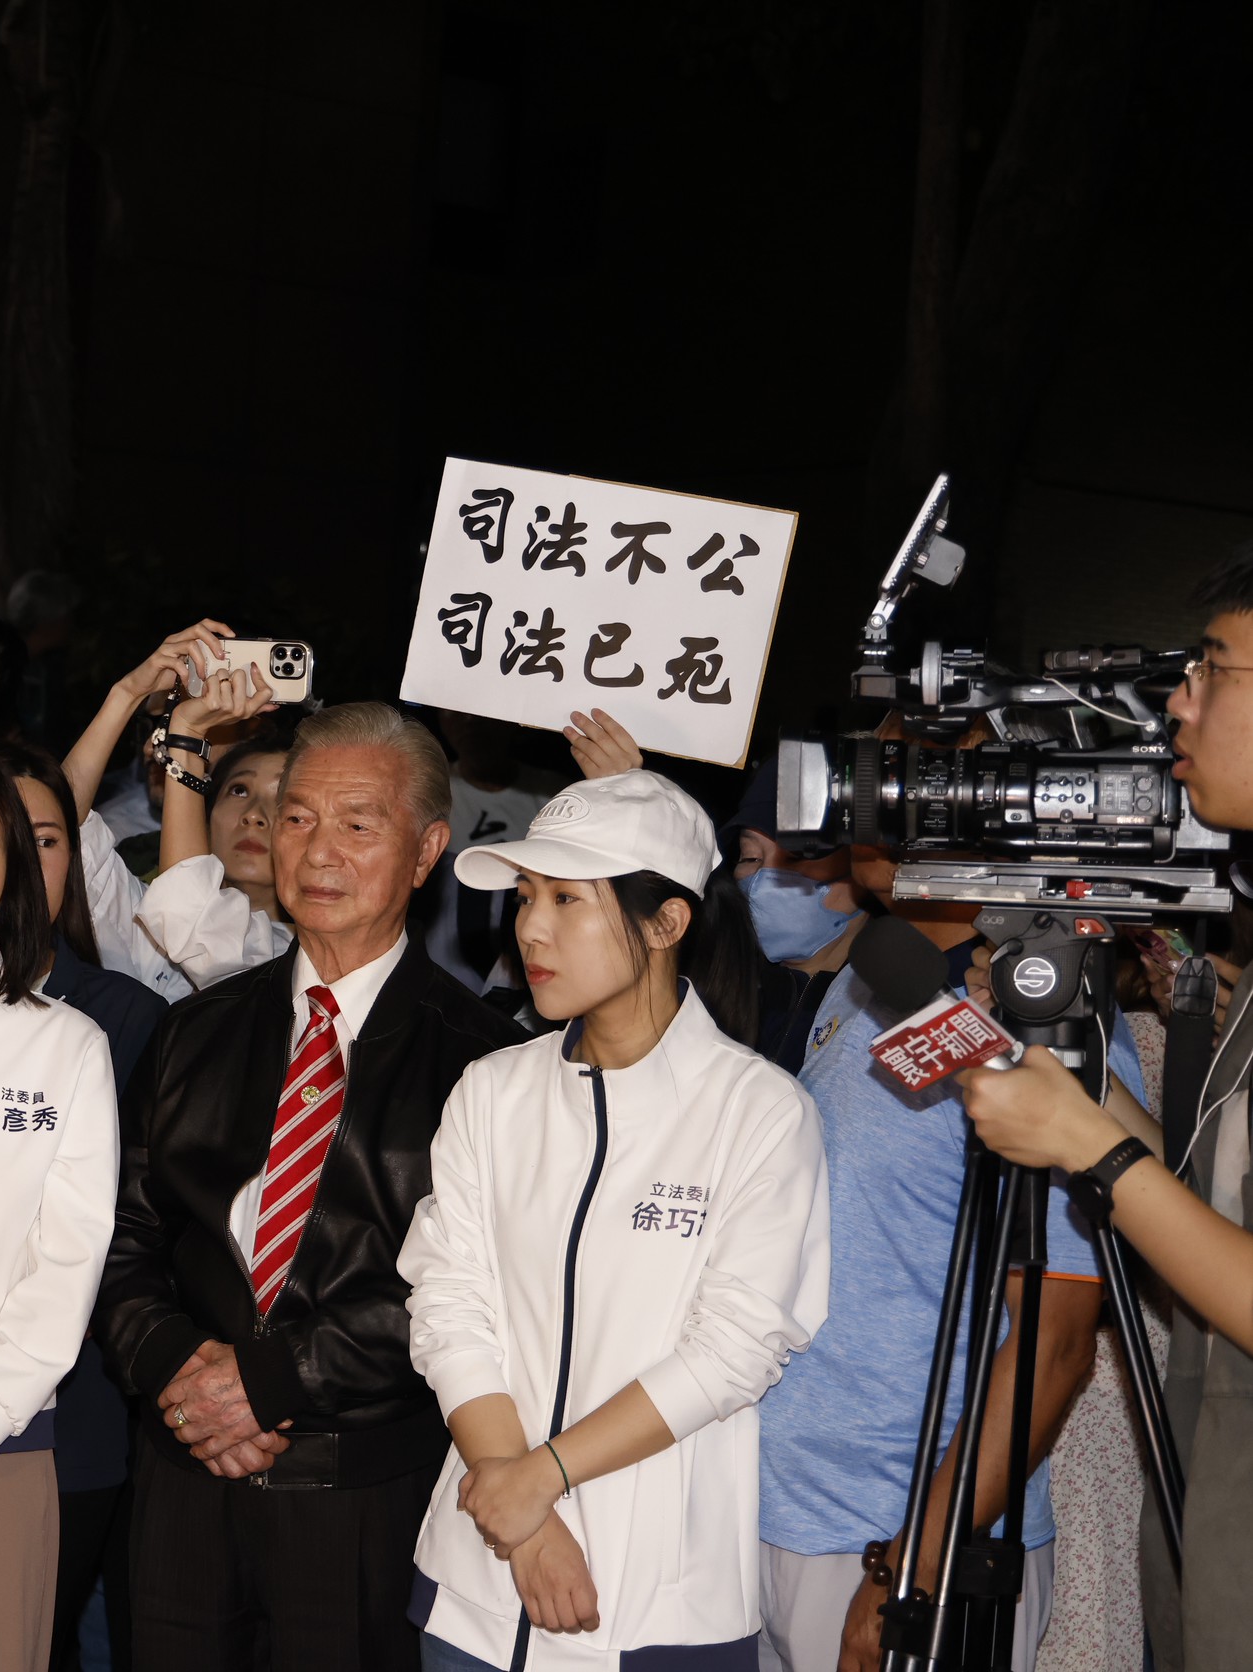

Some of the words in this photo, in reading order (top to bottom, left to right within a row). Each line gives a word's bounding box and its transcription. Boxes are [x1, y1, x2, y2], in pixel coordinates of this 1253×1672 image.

[458, 487, 761, 596] 司法不公
[437, 591, 732, 705] 司法已死
[1132, 745, 1166, 753] SONY
[879, 1007, 998, 1087] 寰宇新聞
